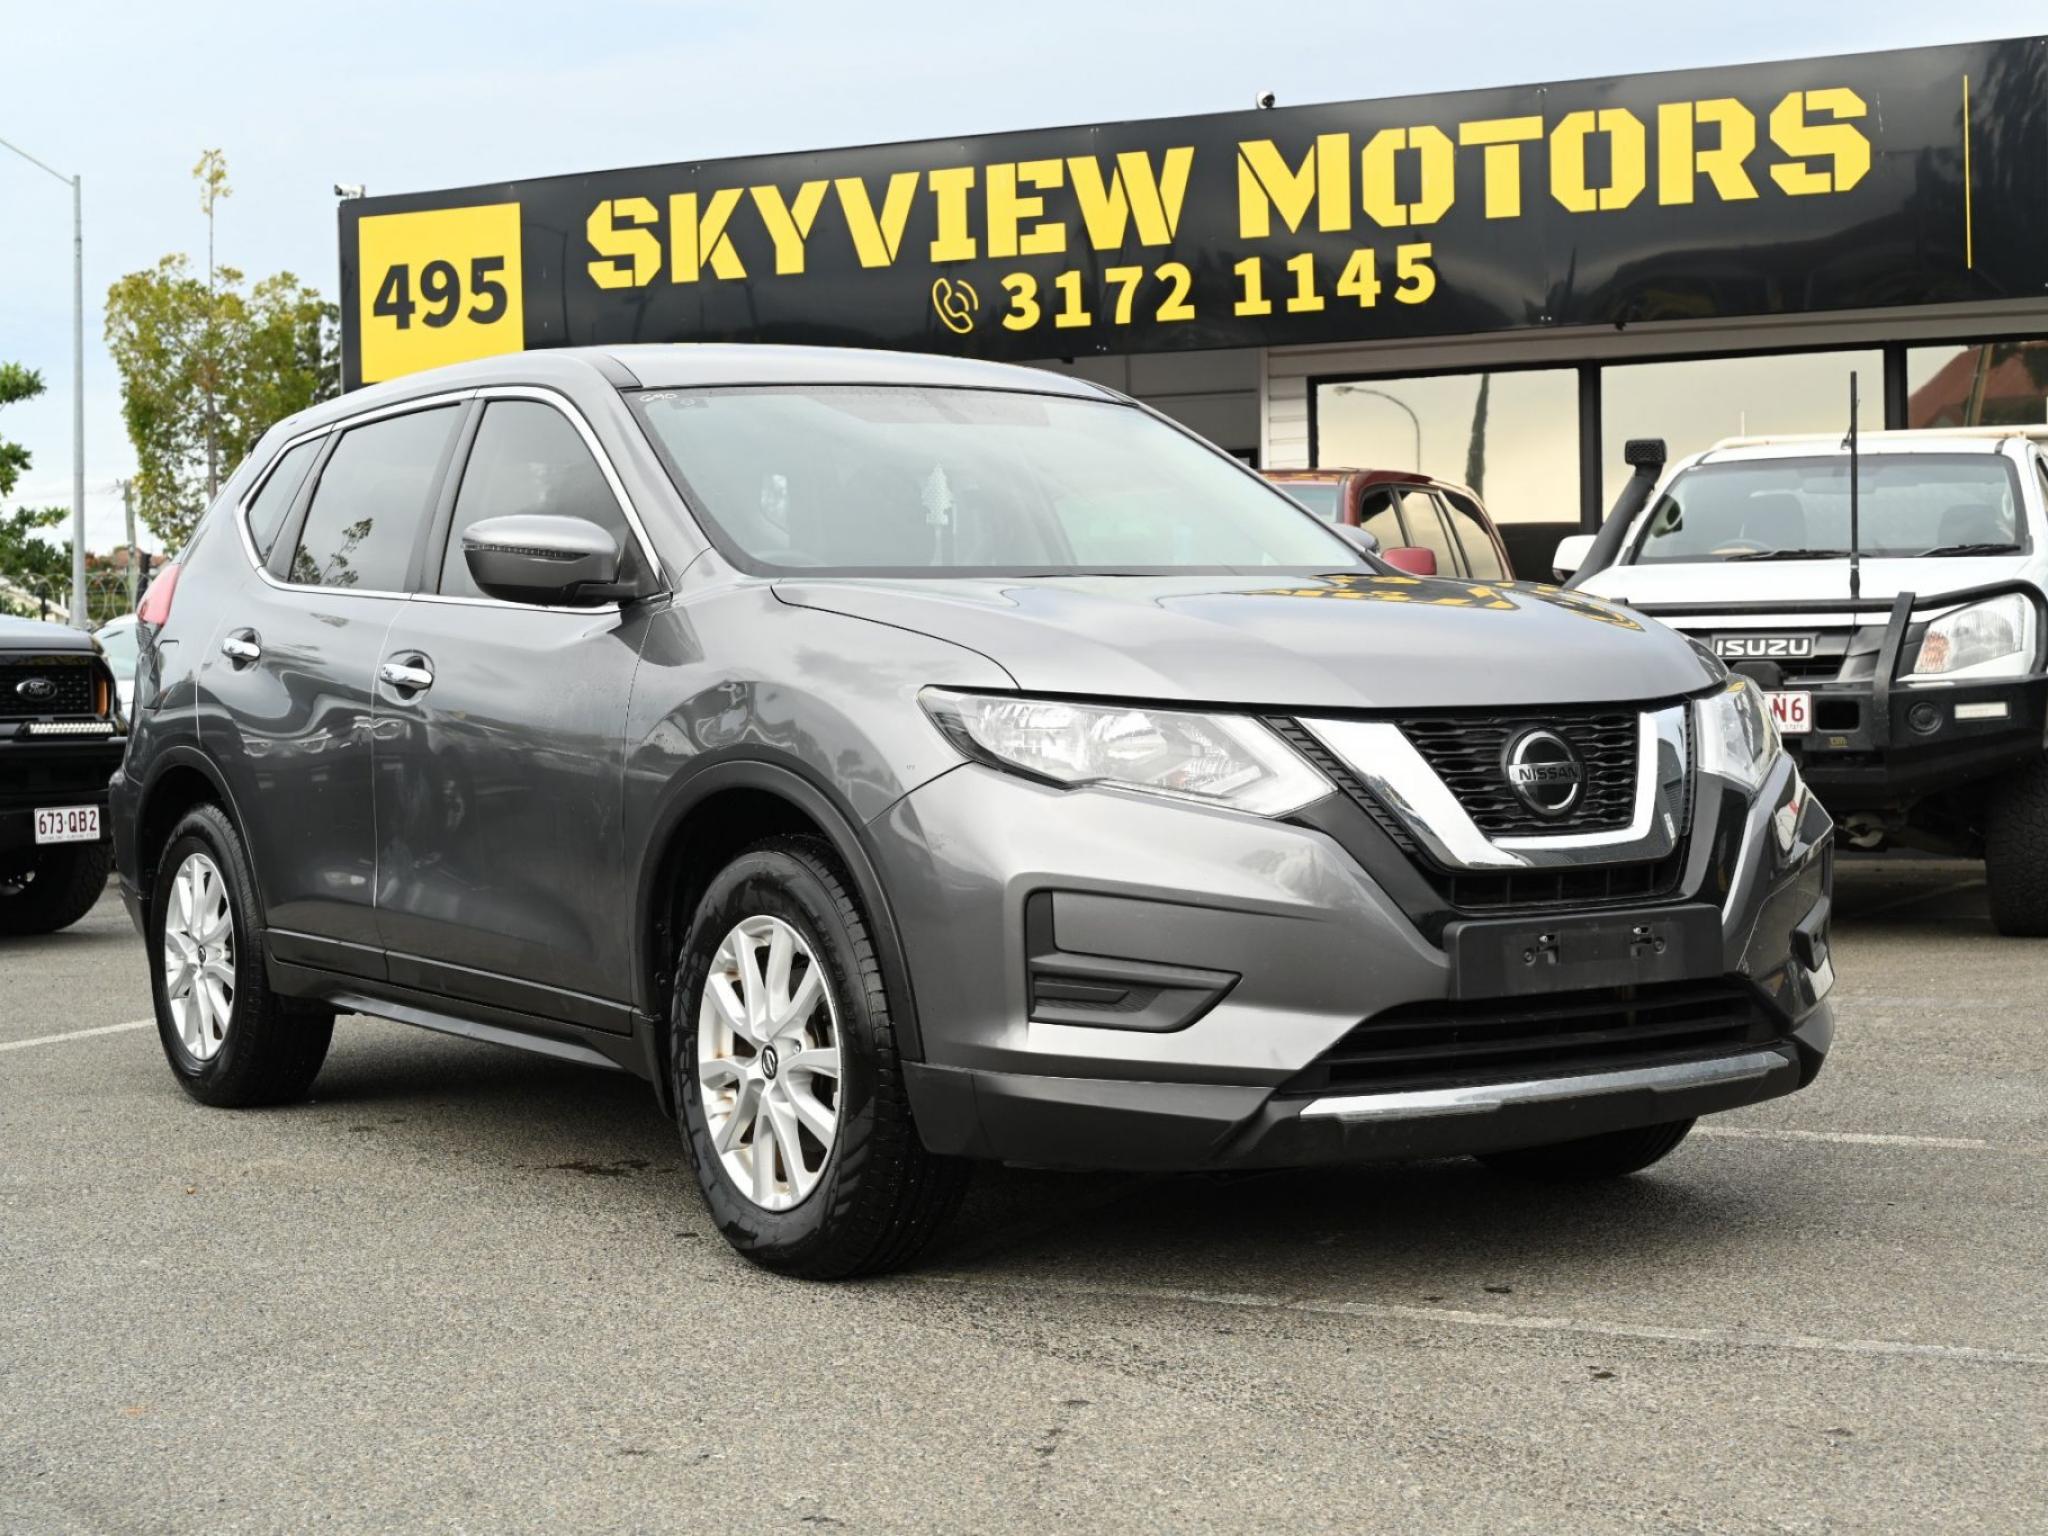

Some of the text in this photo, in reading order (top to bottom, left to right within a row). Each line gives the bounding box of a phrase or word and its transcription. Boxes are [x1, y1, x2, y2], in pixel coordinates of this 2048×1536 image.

[586, 87, 1872, 290] SKYVIEW MOTORS
[372, 255, 508, 330] 495
[1000, 242, 1437, 331] 3172 1145
[1715, 638, 1810, 657] ISUZU
[1517, 765, 1580, 782] NISSAN
